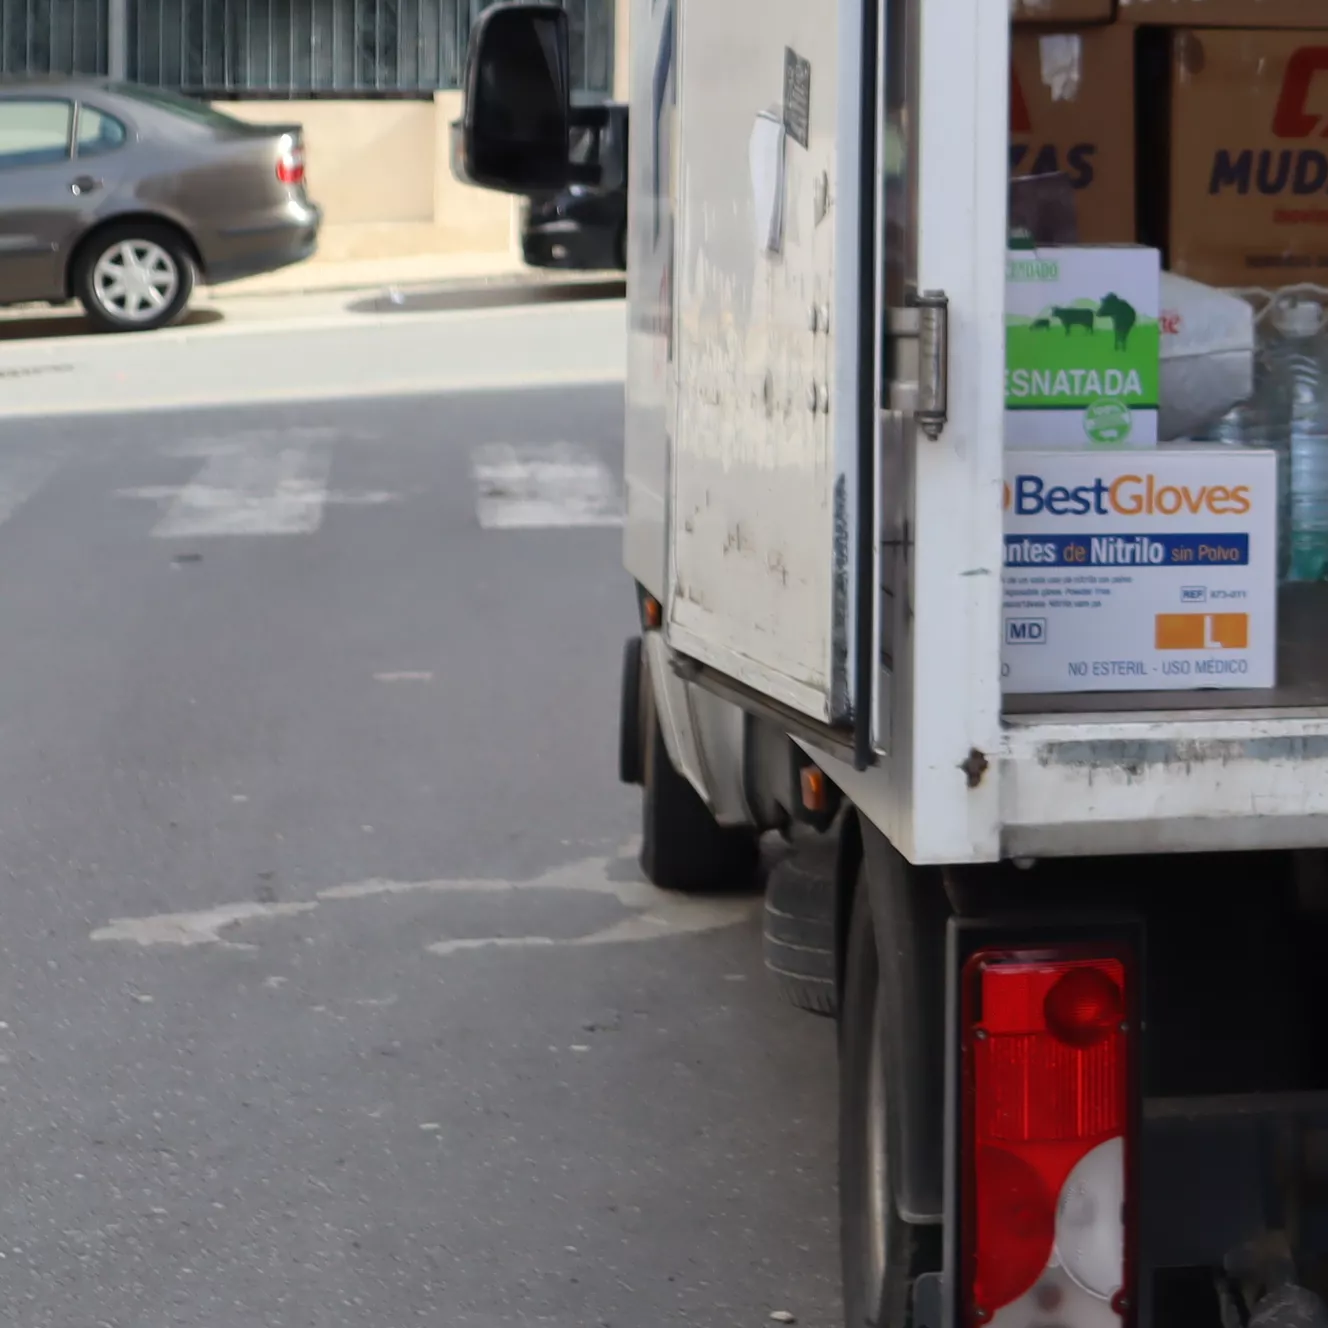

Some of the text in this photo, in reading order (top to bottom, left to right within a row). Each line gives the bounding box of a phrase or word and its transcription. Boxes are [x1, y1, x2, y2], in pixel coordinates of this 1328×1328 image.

[1014, 474, 1252, 516] BestGloves
[1063, 542, 1087, 563] de
[1090, 537, 1164, 564] Nitrilo
[1171, 546, 1194, 562] sin
[1198, 546, 1241, 561] Polvo
[1183, 590, 1202, 599] REF
[1010, 622, 1042, 639] MD
[1204, 614, 1223, 649] L
[1068, 660, 1088, 676] NO
[1092, 660, 1147, 676] ESTERIL
[1162, 660, 1190, 676] USO
[1195, 656, 1248, 675] MÉDICO
